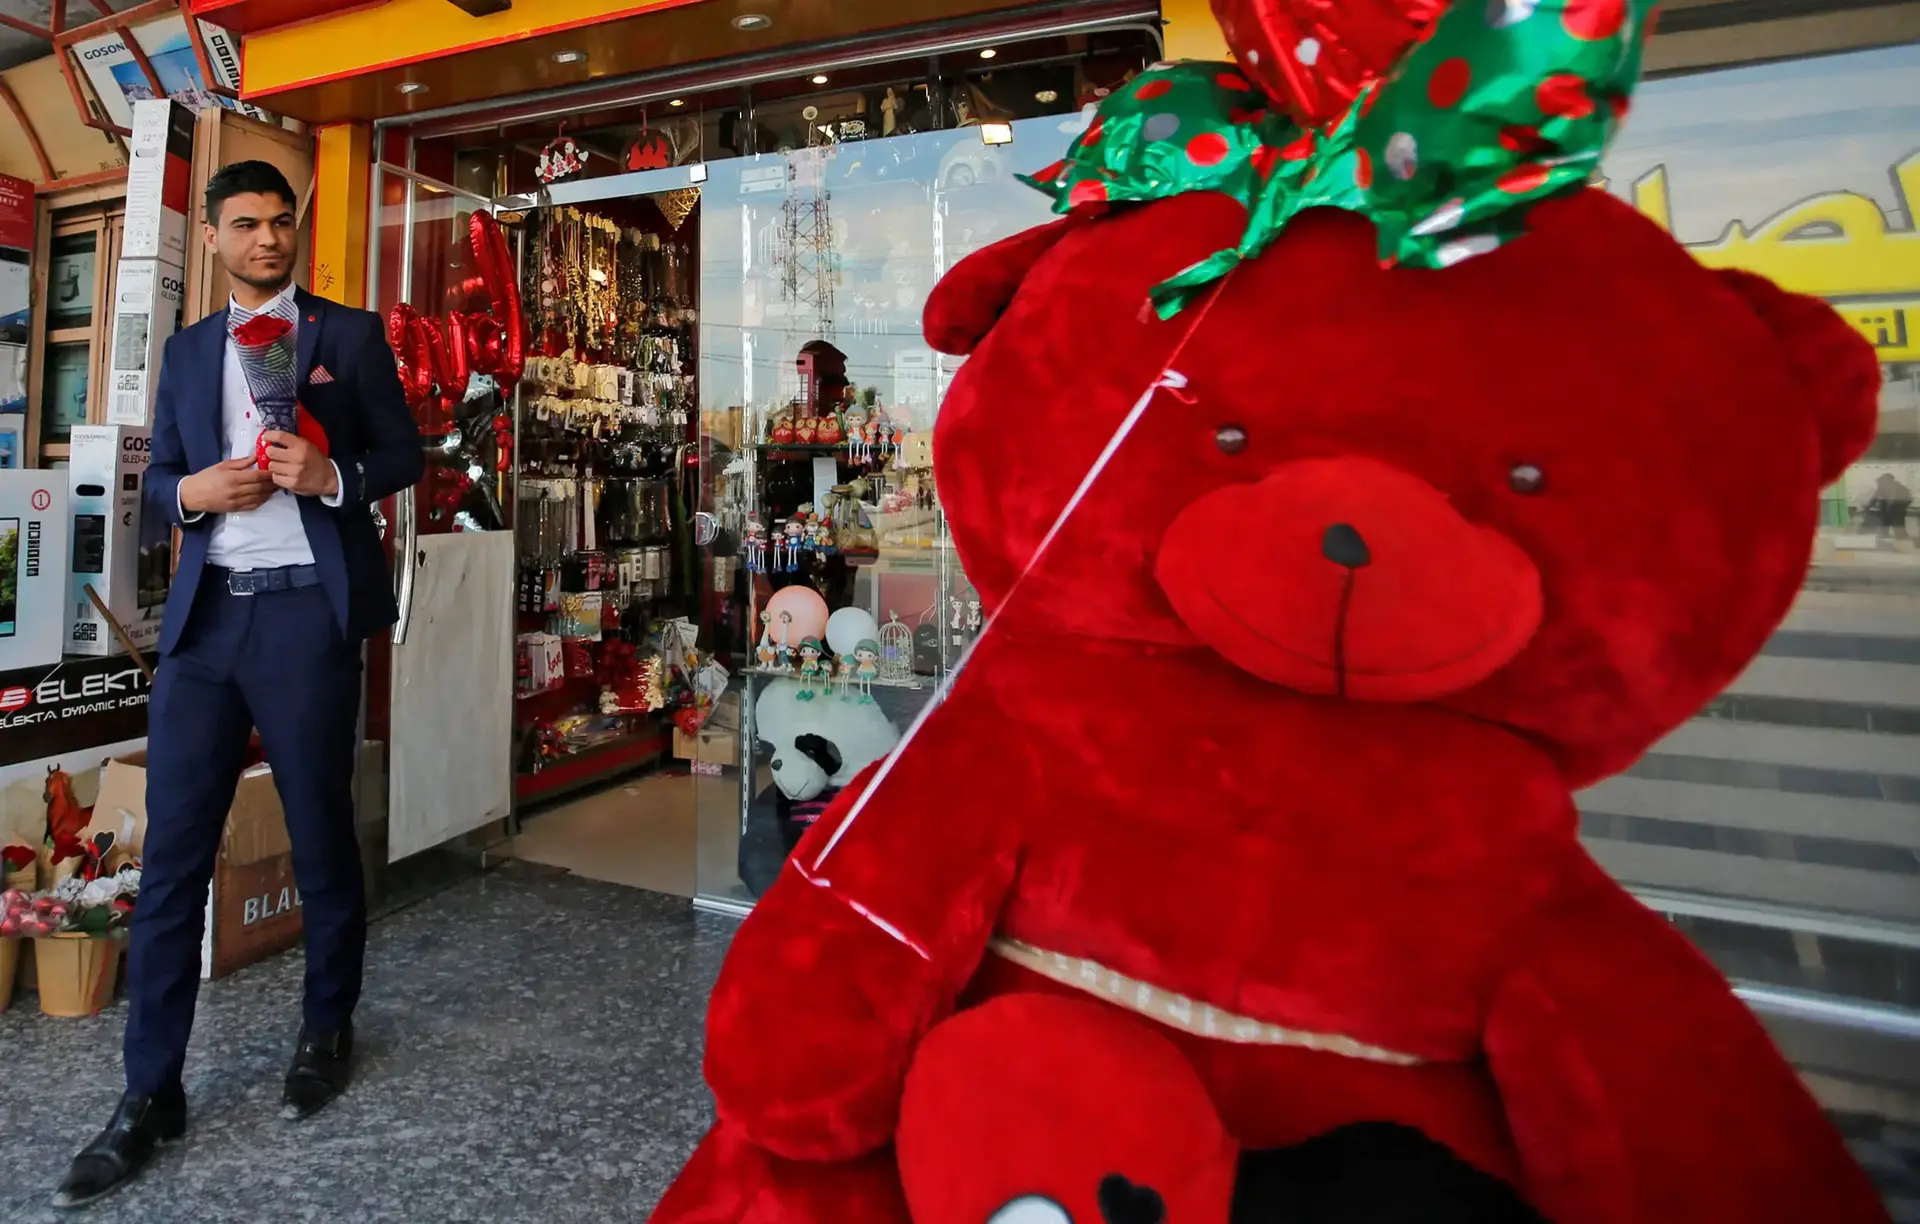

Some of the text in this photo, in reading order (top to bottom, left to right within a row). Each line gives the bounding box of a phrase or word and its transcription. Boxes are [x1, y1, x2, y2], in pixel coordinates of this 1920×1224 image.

[84, 42, 127, 60] GOSON
[62, 699, 116, 718] DYNAMIC
[119, 694, 149, 708] HOM
